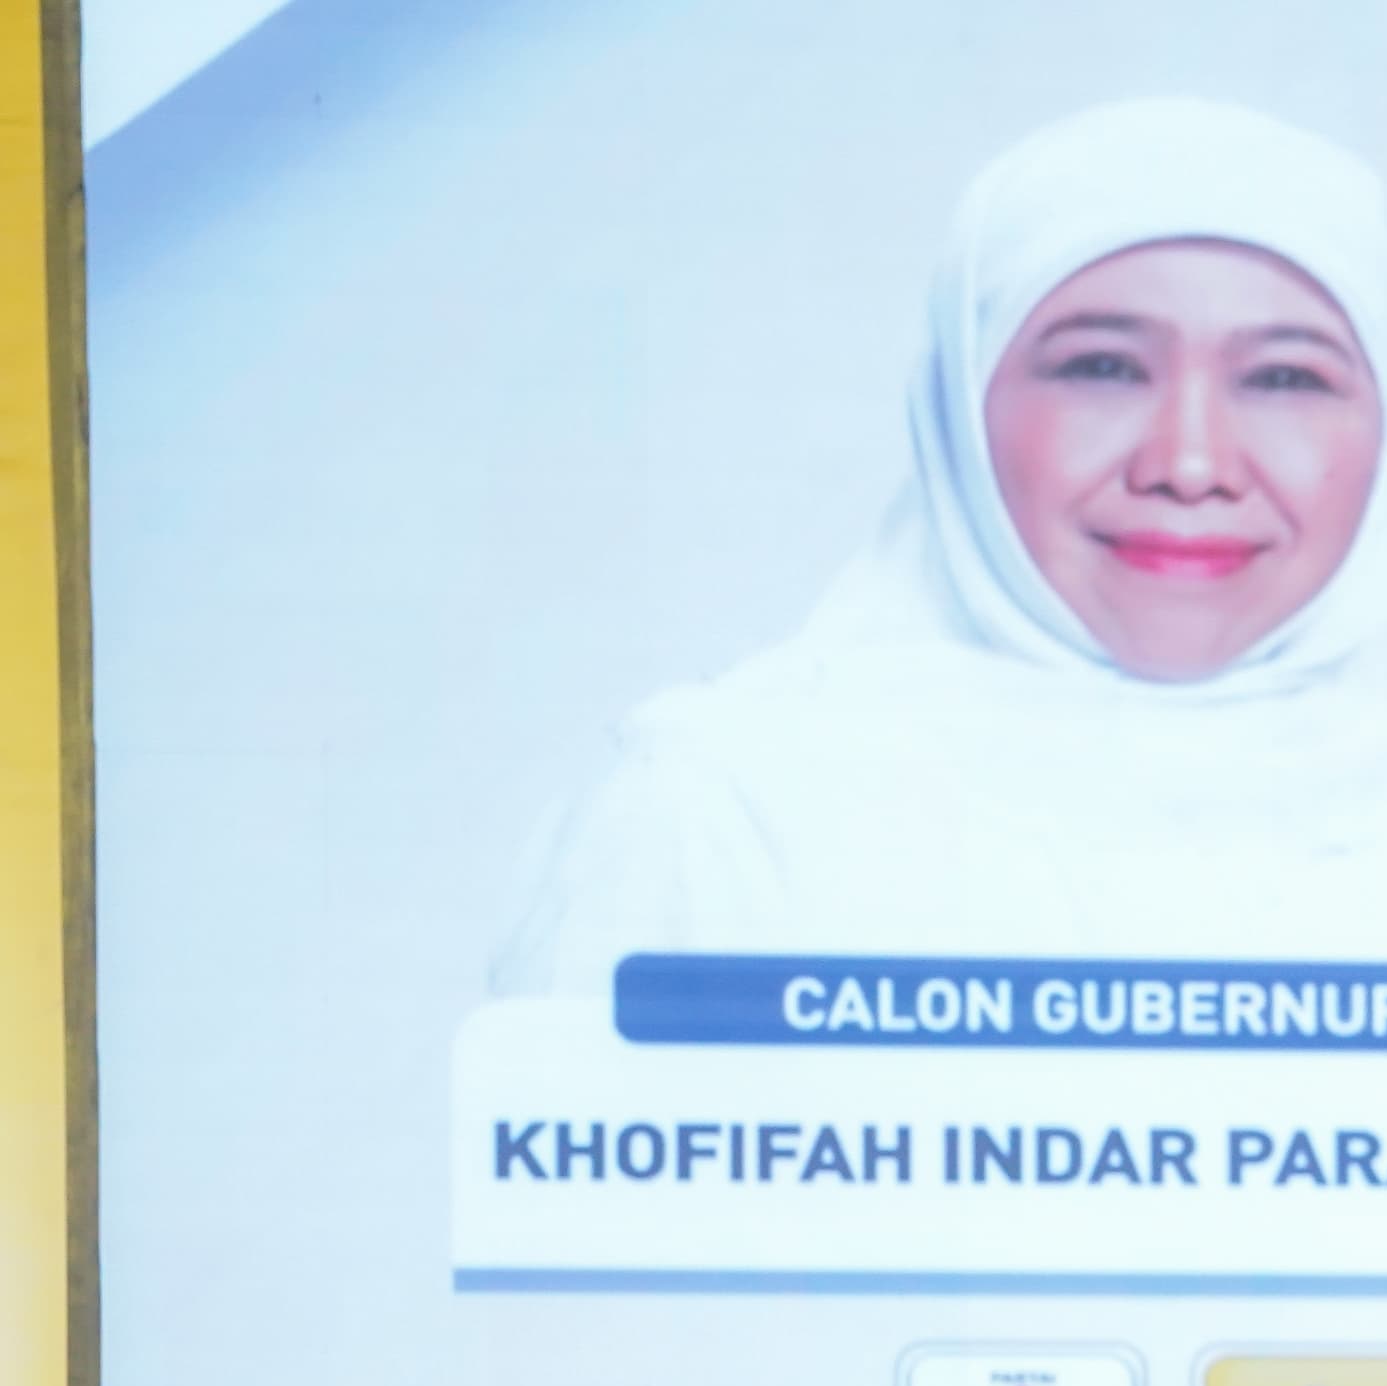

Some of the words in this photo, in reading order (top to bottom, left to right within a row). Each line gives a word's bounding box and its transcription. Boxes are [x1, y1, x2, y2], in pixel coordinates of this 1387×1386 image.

[784, 977, 1012, 1034] CALON
[495, 1121, 911, 1182] KHOFIFAH
[944, 1125, 1197, 1185] INDAR
